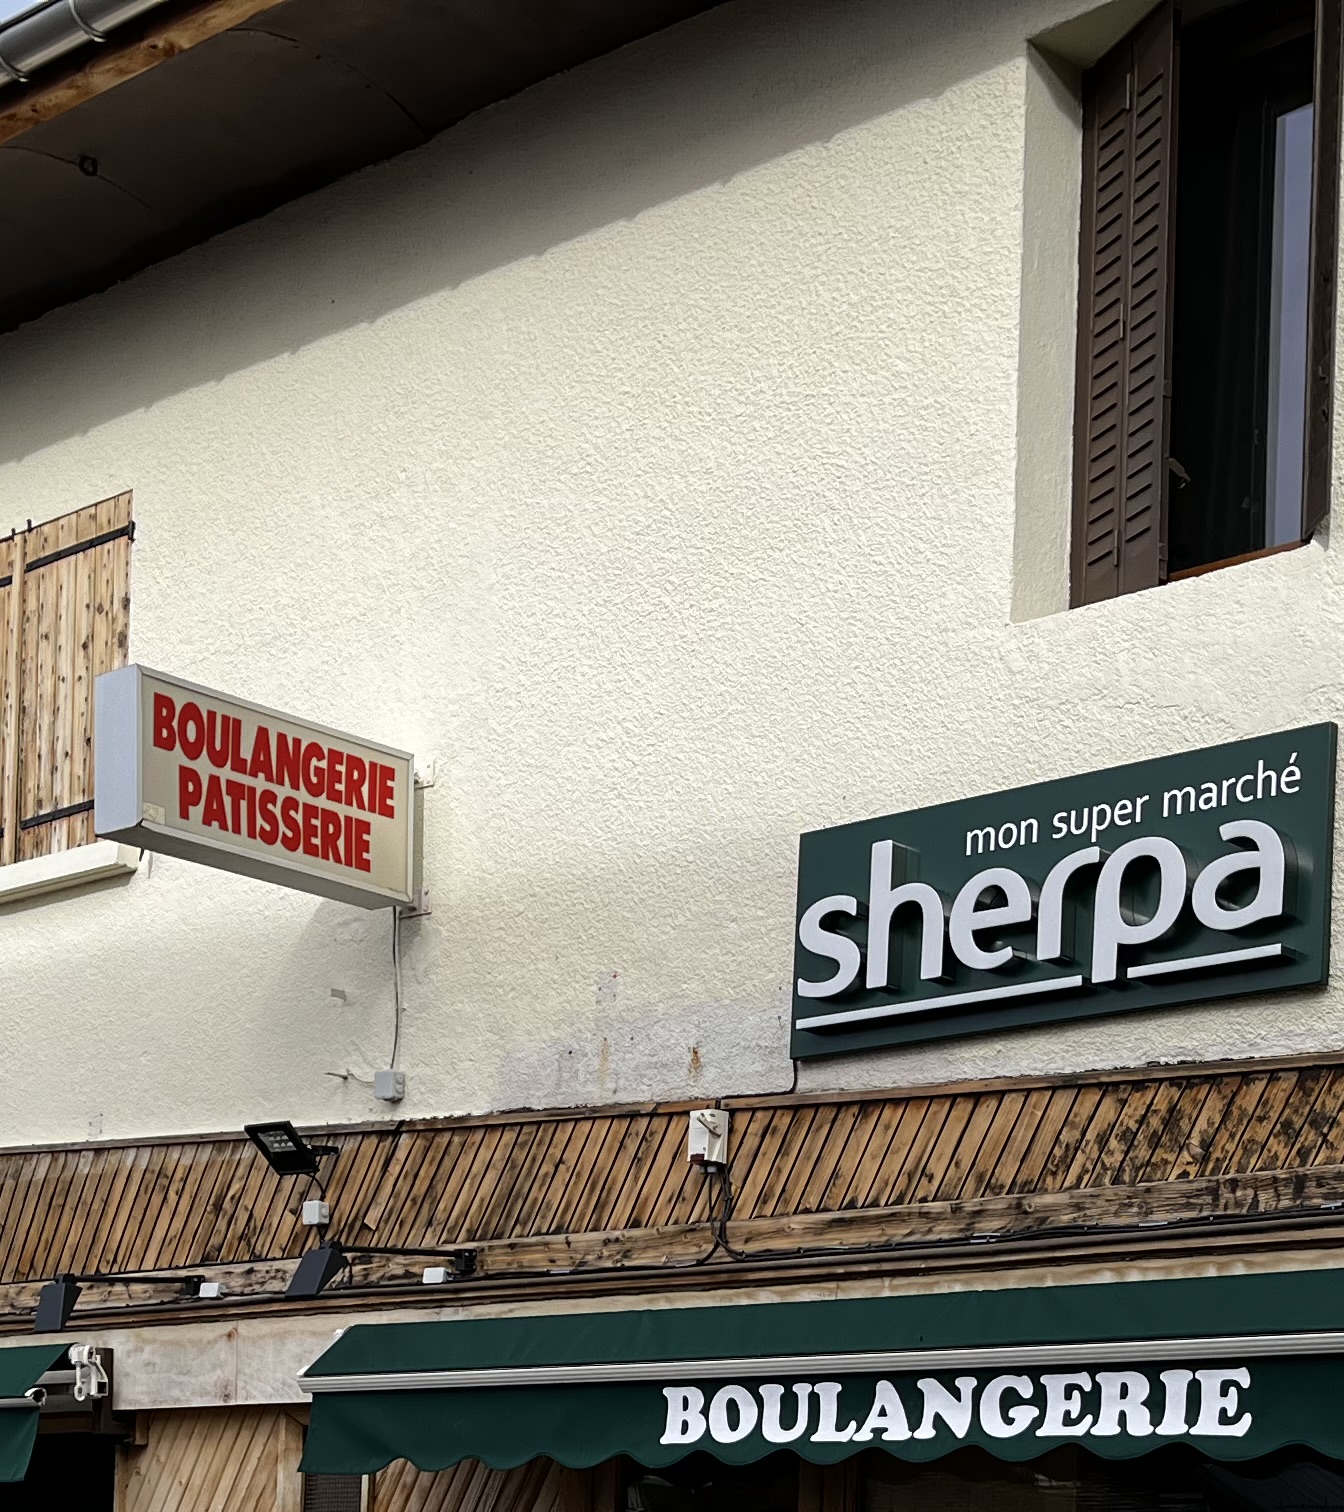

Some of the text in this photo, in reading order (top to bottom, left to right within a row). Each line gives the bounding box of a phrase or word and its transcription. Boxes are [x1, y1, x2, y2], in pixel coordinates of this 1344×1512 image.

[153, 691, 396, 820] BOULANGERIE
[964, 752, 1303, 857] mon super marché
[178, 764, 372, 874] PATISSERIE
[796, 819, 1286, 998] sherpa
[659, 1367, 1253, 1445] BOULANGERIE
